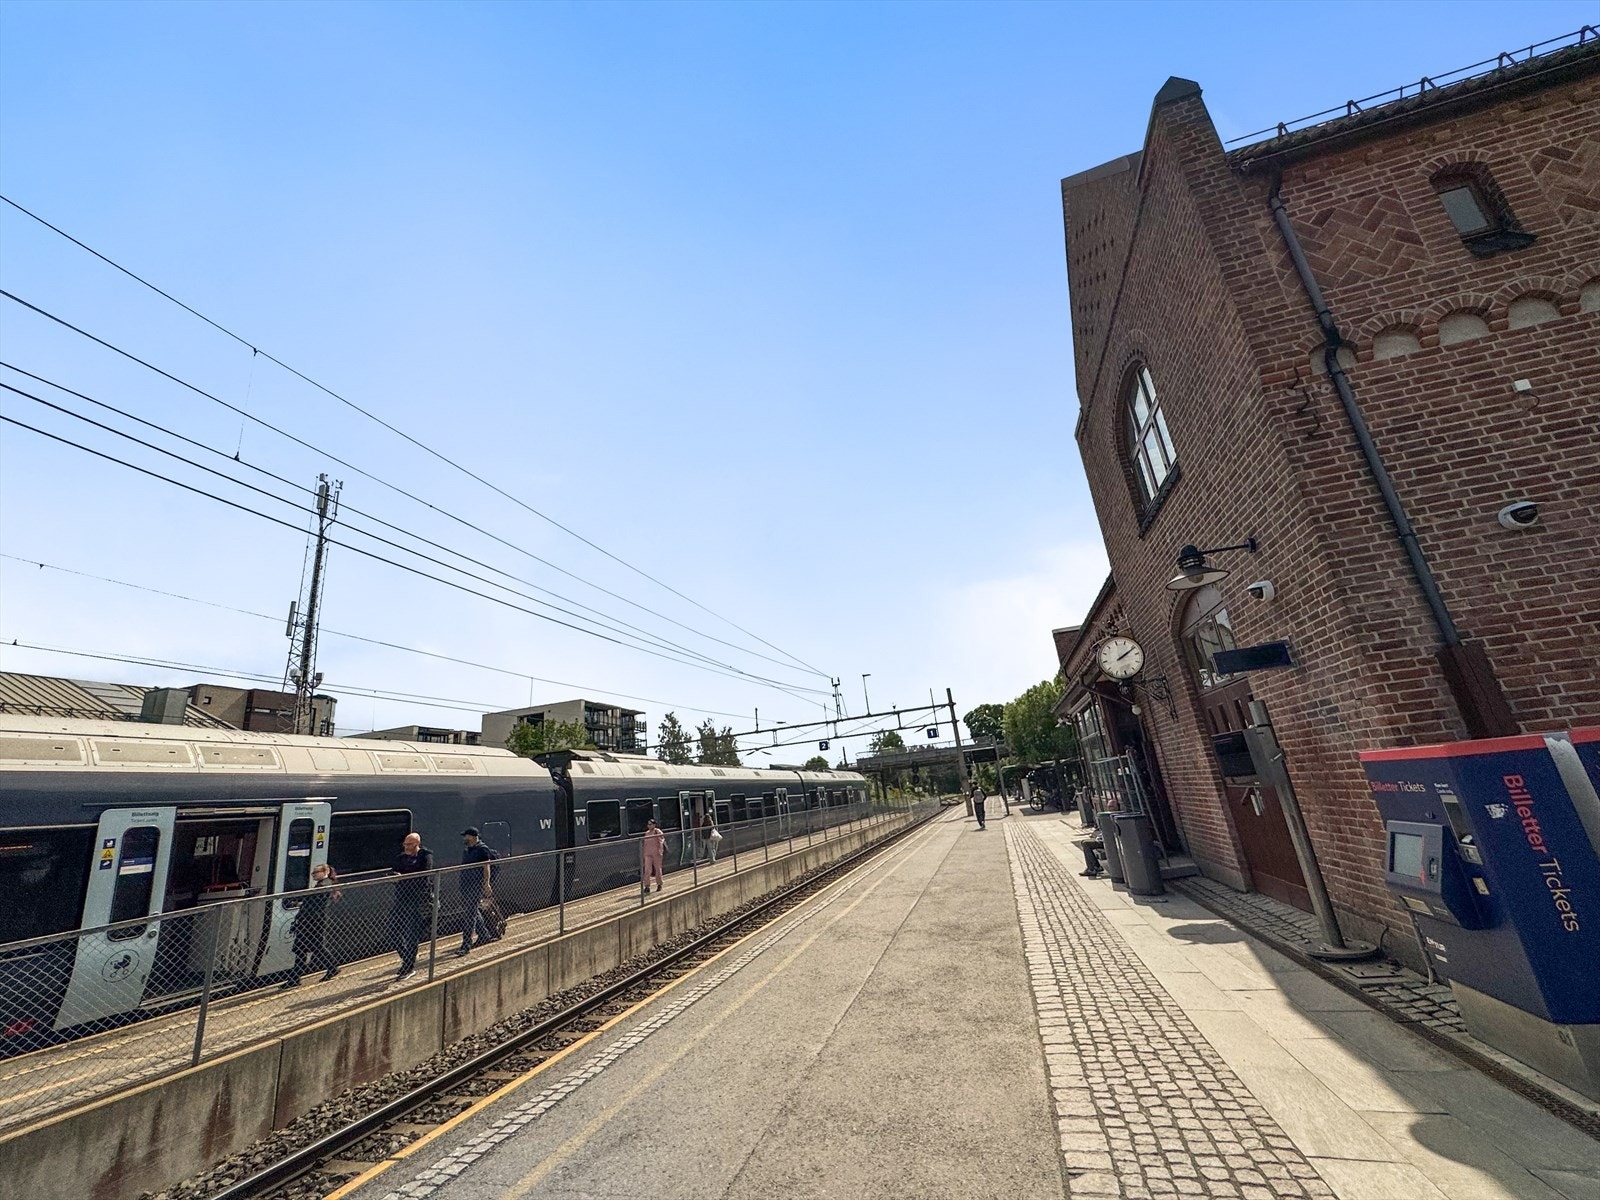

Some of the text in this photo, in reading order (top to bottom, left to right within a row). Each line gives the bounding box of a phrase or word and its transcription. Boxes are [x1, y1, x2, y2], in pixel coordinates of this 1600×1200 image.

[1397, 780, 1426, 793] Tickets
[1503, 774, 1580, 932] Billetter Tickets
